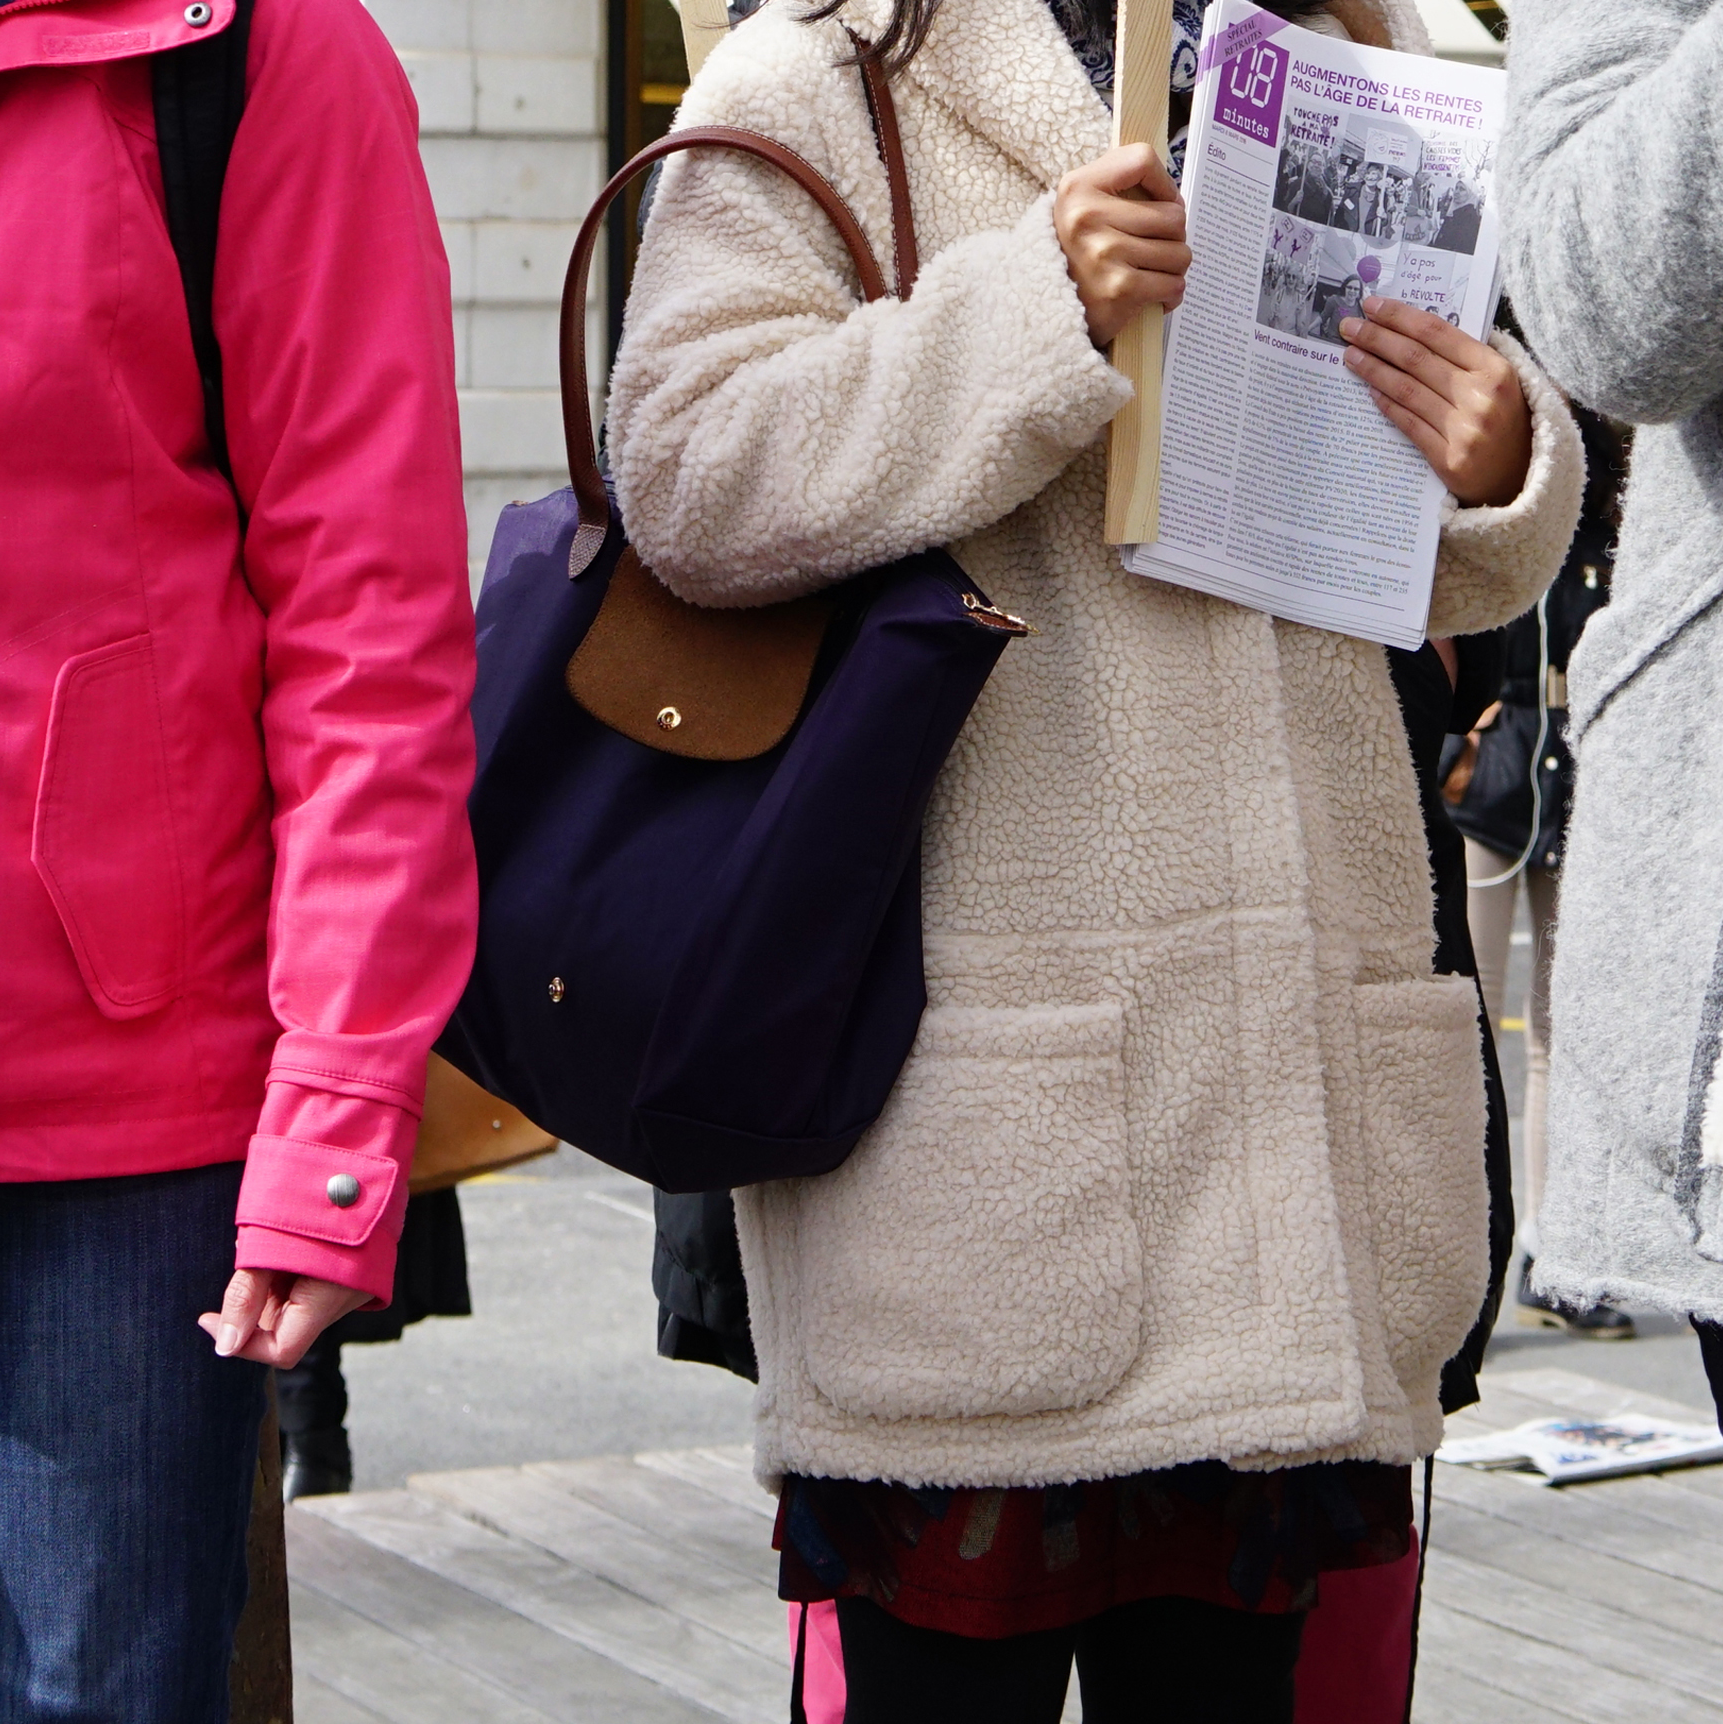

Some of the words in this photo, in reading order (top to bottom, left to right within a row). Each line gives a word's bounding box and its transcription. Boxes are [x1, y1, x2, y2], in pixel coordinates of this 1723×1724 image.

[1224, 30, 1263, 57] RETRAITES
[1290, 75, 1312, 93] PAS
[1314, 83, 1353, 105] L'ÂGE
[1356, 95, 1378, 110] DE
[1381, 100, 1400, 115] LA
[1404, 105, 1476, 129] RETRAITE
[1292, 60, 1389, 95] AUGMENTONS
[1393, 85, 1421, 102] LES
[1424, 91, 1483, 113] RENTES
[1222, 107, 1270, 138] minutes
[1294, 107, 1321, 122] TOUCHE
[1419, 259, 1436, 271] pas
[1254, 329, 1271, 345] Vent
[1271, 338, 1309, 357] contraire
[1310, 349, 1328, 361] sur
[1329, 353, 1339, 365] le
